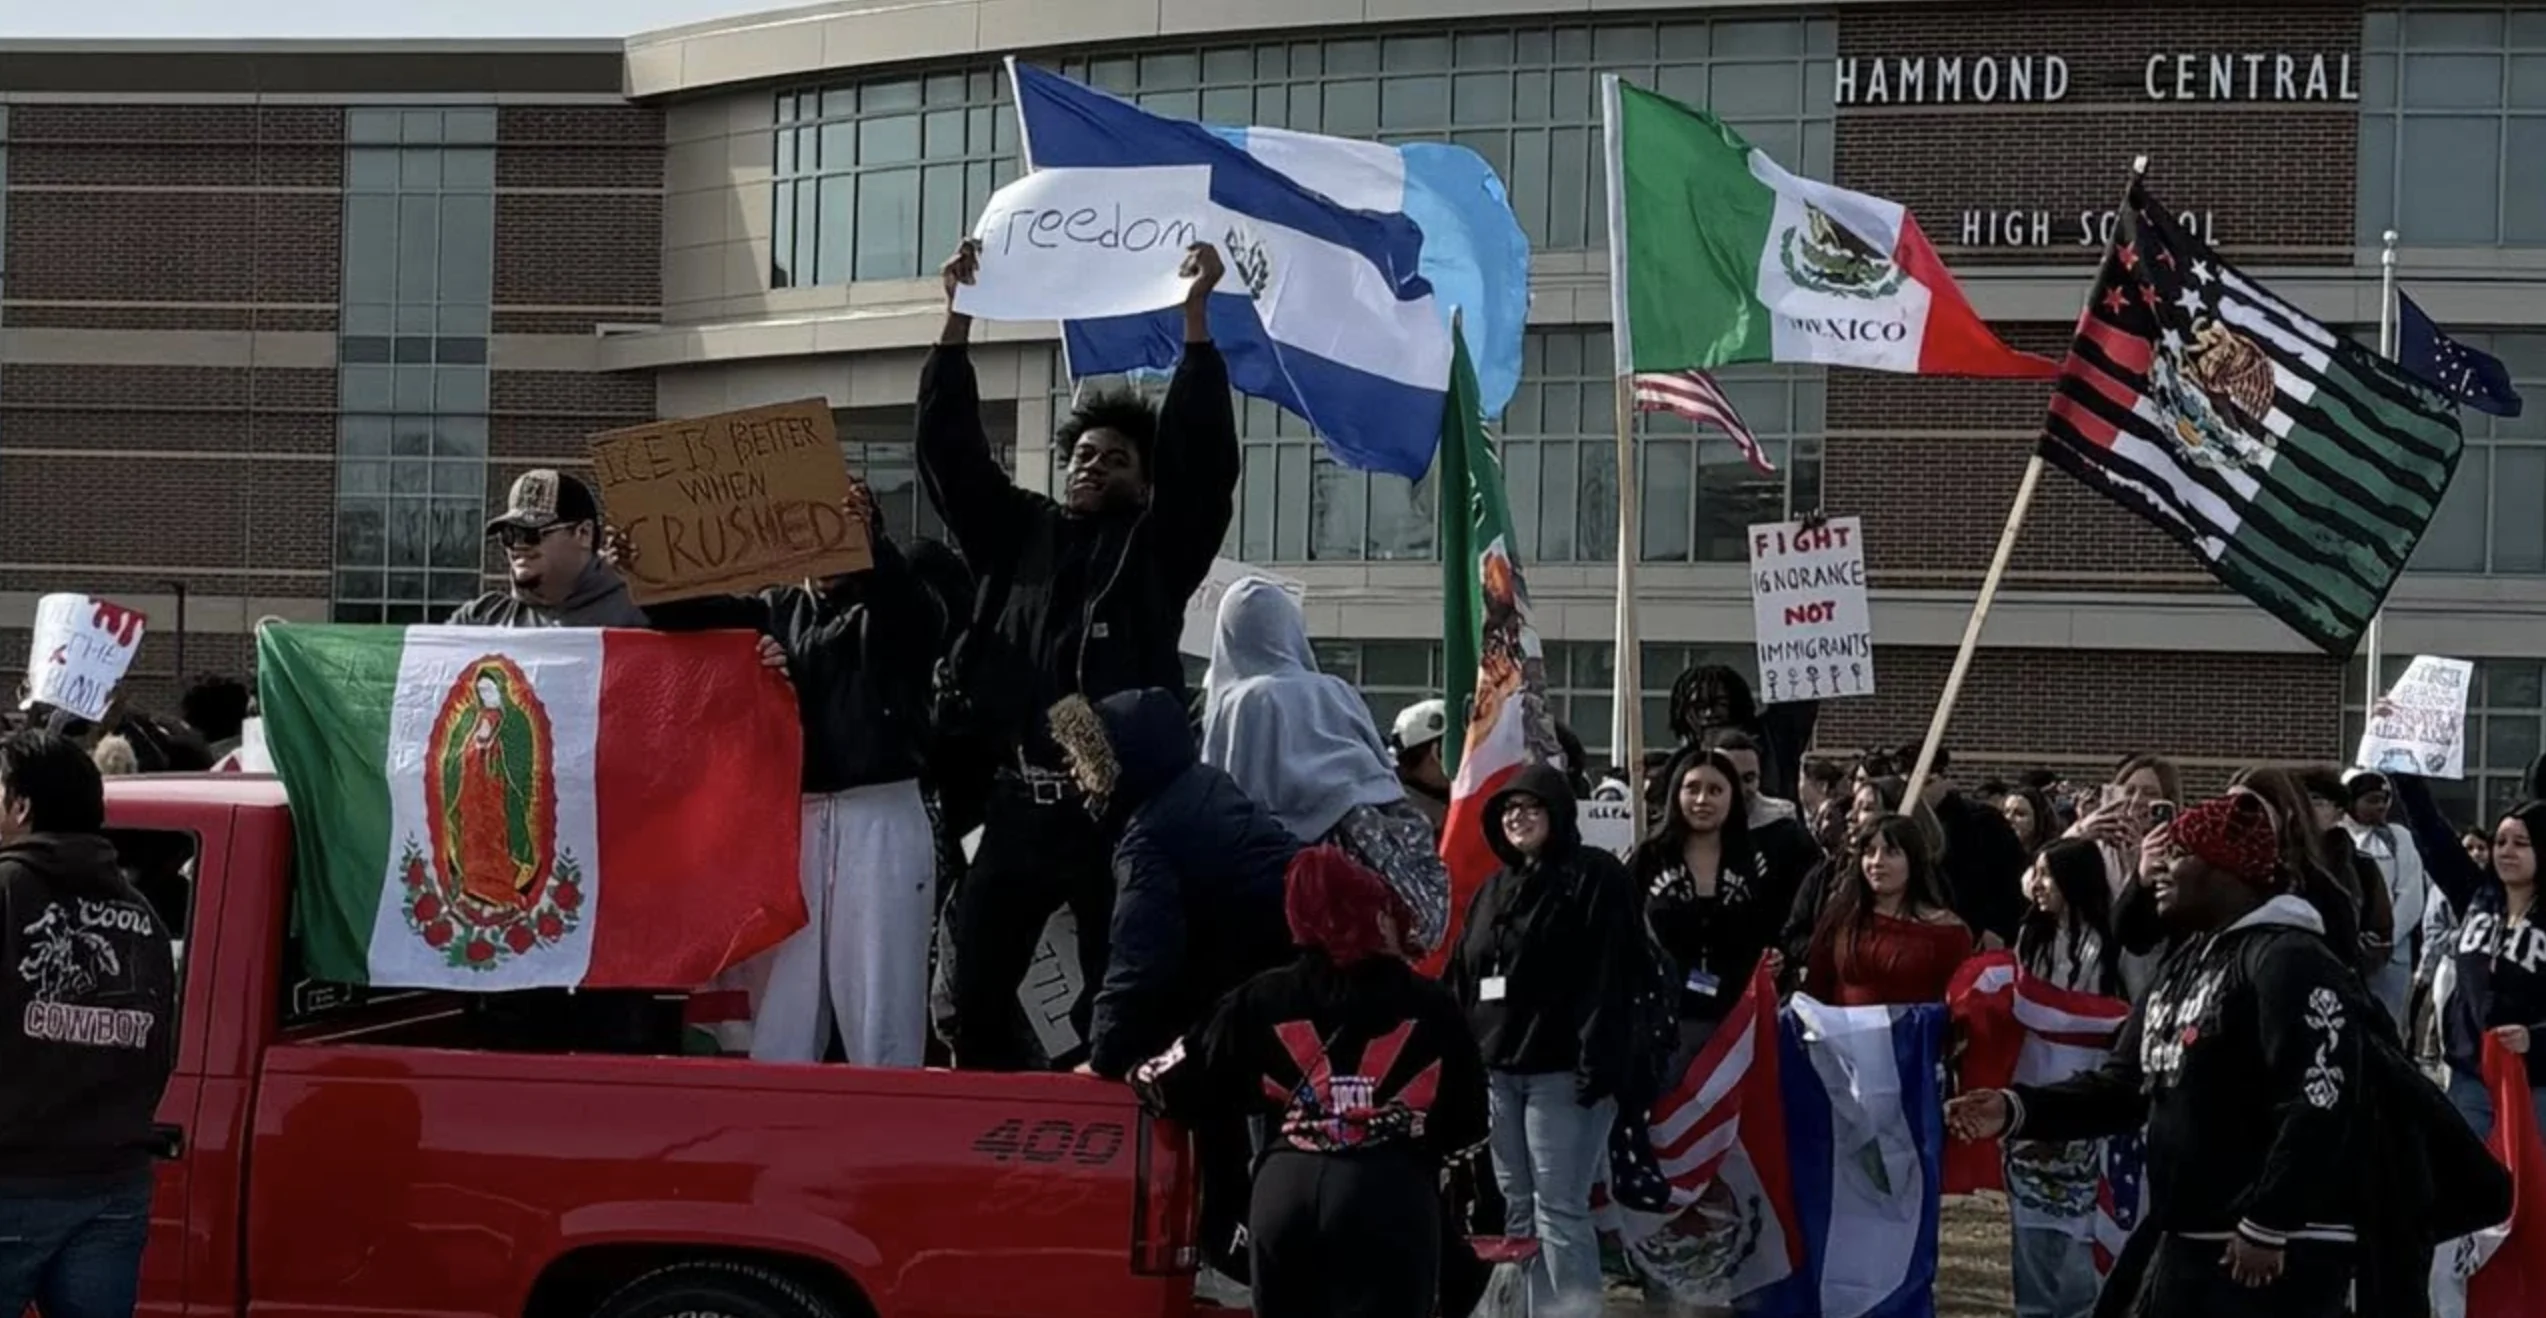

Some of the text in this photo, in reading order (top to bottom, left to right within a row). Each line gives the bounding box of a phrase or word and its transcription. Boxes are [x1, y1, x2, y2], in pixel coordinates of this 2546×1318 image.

[1834, 53, 2360, 103] HAMMOND CENTRAL
[1962, 210, 2220, 246] HIGH SCOL
[591, 416, 826, 488] ICE IS BETTER
[676, 471, 768, 505] WHEN
[622, 501, 849, 585] CRUSHED
[1754, 526, 1851, 558] FIGHT
[1754, 560, 1865, 594] IGNORANCE
[1784, 601, 1837, 626] NOT
[1761, 632, 1871, 663] IMMIGRANTS
[77, 896, 153, 937] Coors
[24, 1001, 155, 1049] COWBOY
[971, 1118, 1125, 1165] 400
